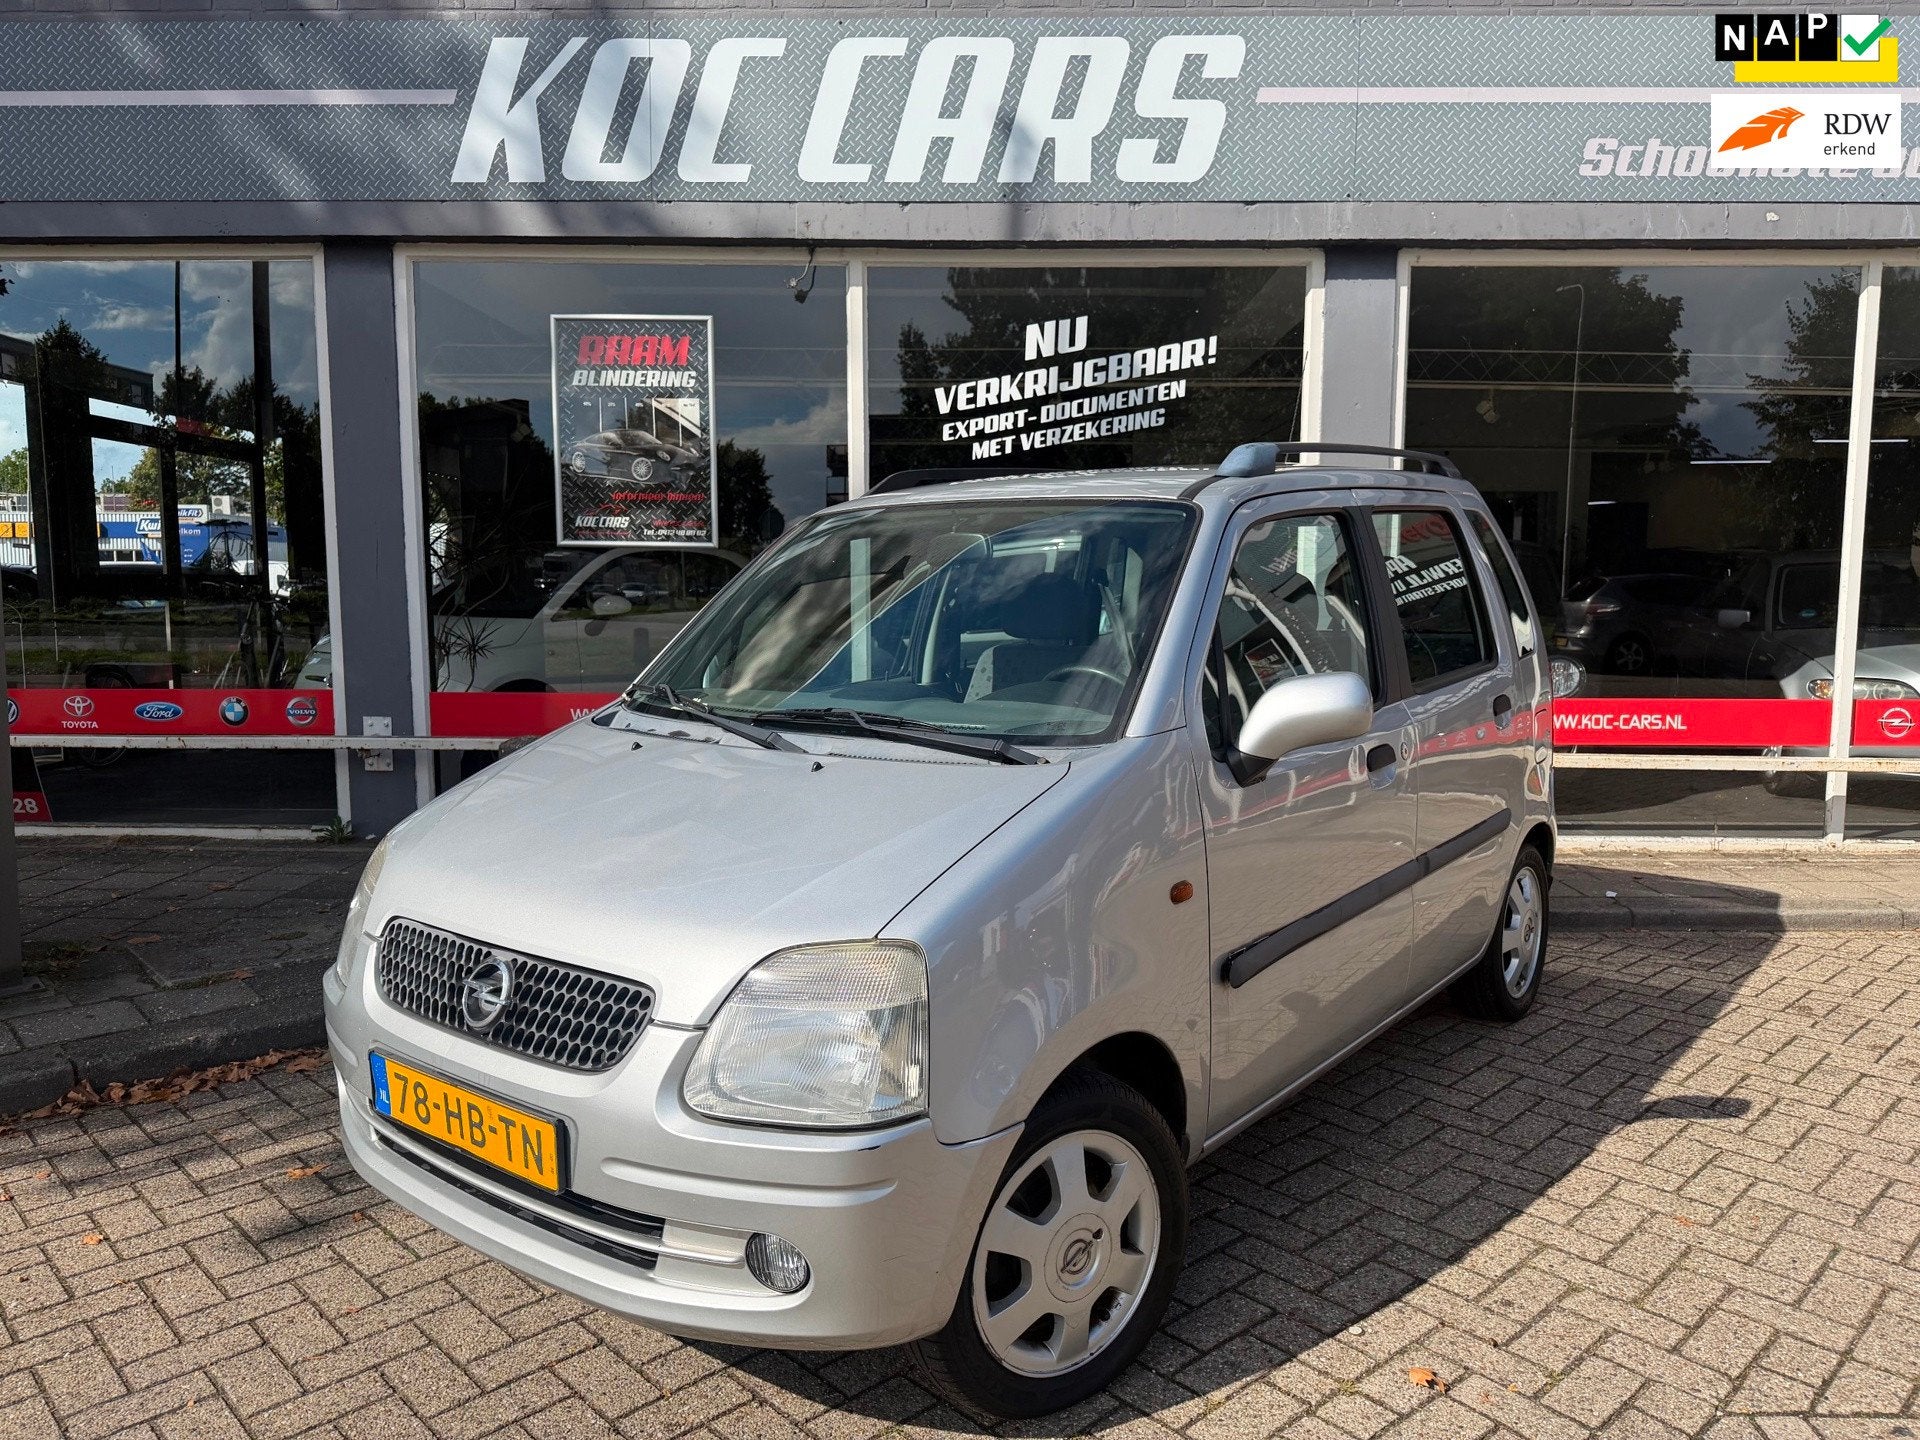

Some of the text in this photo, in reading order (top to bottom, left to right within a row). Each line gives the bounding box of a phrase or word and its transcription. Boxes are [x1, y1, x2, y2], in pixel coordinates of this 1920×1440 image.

[451, 35, 1246, 183] KOC CARS
[577, 335, 691, 366] RAAM
[1024, 315, 1089, 361] NU
[572, 369, 697, 387] BLINDERING
[934, 335, 1218, 415] VERKRIJGBAAR!
[972, 408, 1166, 460] MET VERZEKERING
[575, 516, 630, 528] KOC CARS
[61, 720, 99, 729] TOYOTA
[143, 704, 174, 718] Ford
[394, 1072, 544, 1176] 78-HB-TN
